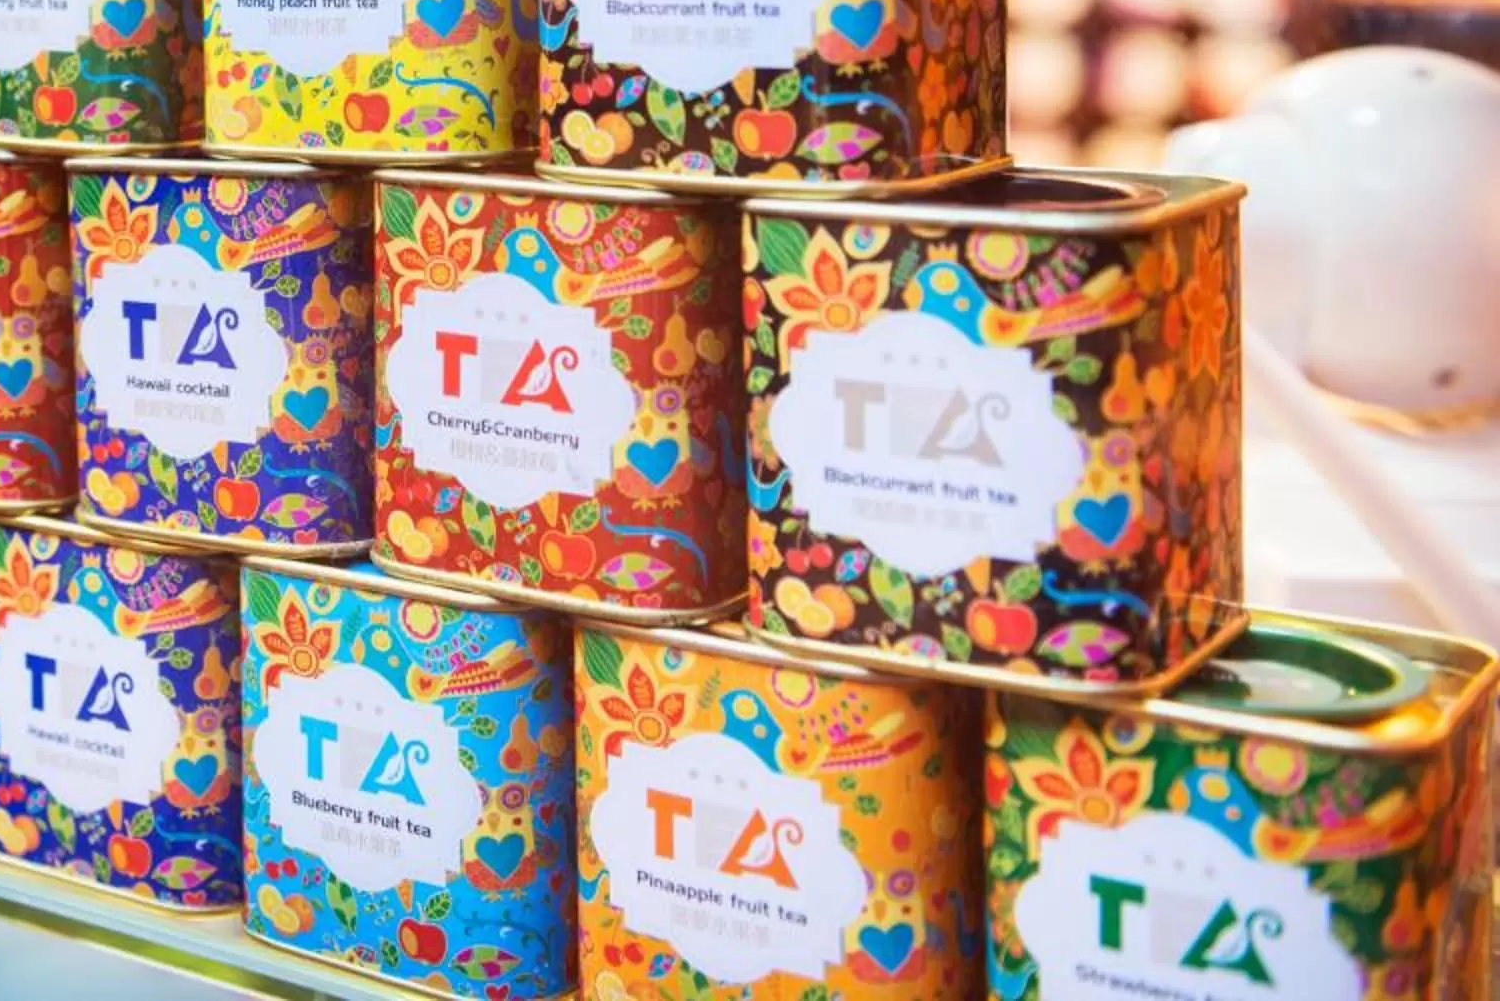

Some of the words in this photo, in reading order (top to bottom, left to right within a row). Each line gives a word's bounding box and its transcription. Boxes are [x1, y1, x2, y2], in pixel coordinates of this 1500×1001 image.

[712, 0, 747, 18] fruit
[753, 2, 781, 18] tea
[126, 374, 171, 393] Hawaii
[175, 382, 231, 399] cocktail
[427, 410, 580, 451] Cherry&Cranberry
[941, 482, 981, 504] fruit
[987, 489, 1019, 506] tea
[292, 790, 363, 824] Blueberry
[368, 810, 402, 832] fruit
[406, 820, 432, 839] tea
[637, 869, 724, 907] Pinaapple
[731, 893, 770, 918] fruit
[778, 904, 809, 927] tea
